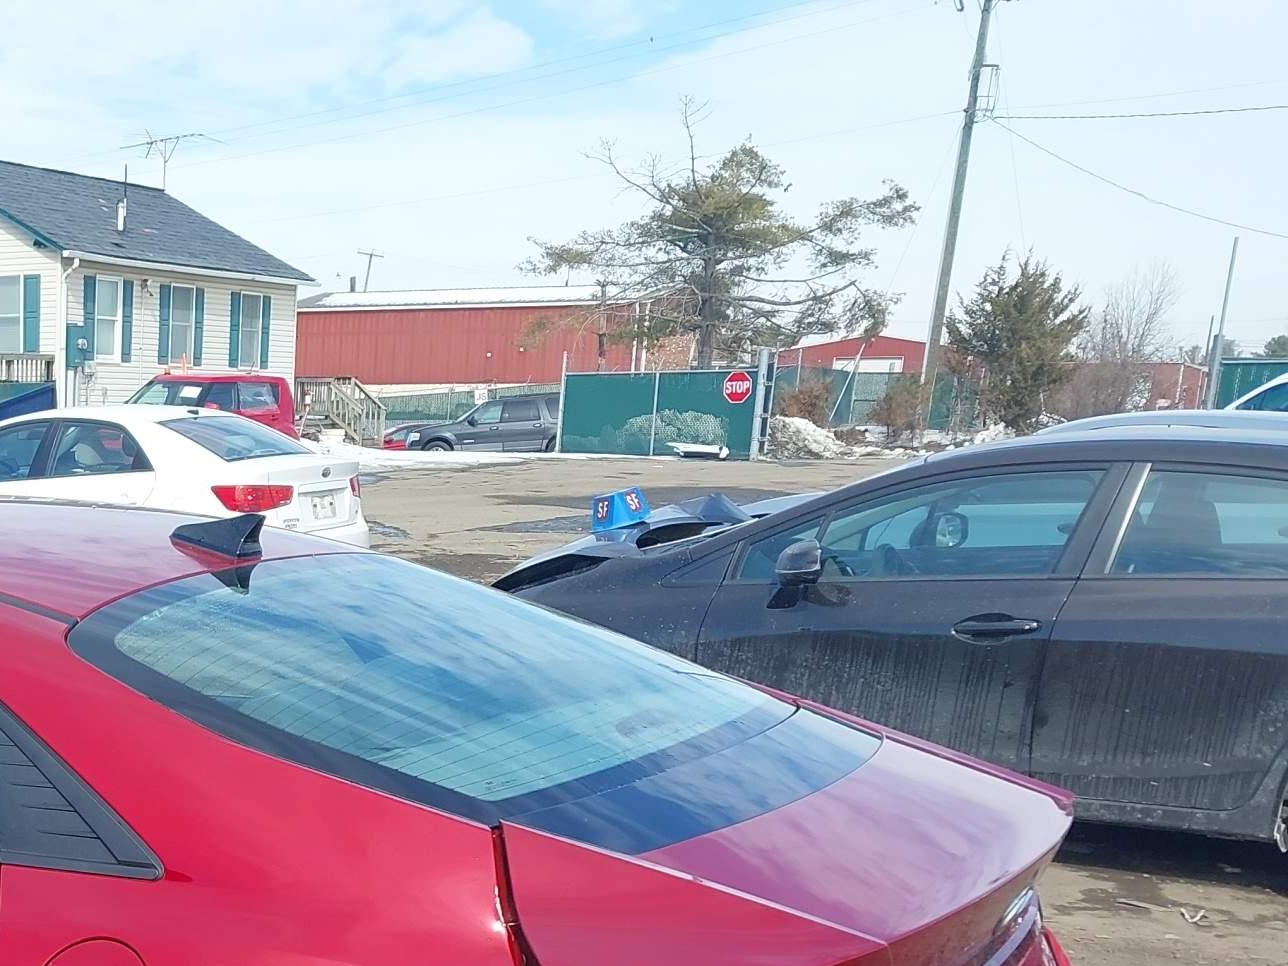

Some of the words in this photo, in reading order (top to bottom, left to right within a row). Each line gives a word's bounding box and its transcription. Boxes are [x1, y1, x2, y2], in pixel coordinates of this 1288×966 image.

[725, 380, 750, 394] STOP
[597, 501, 609, 518] SF
[625, 493, 641, 511] SF
